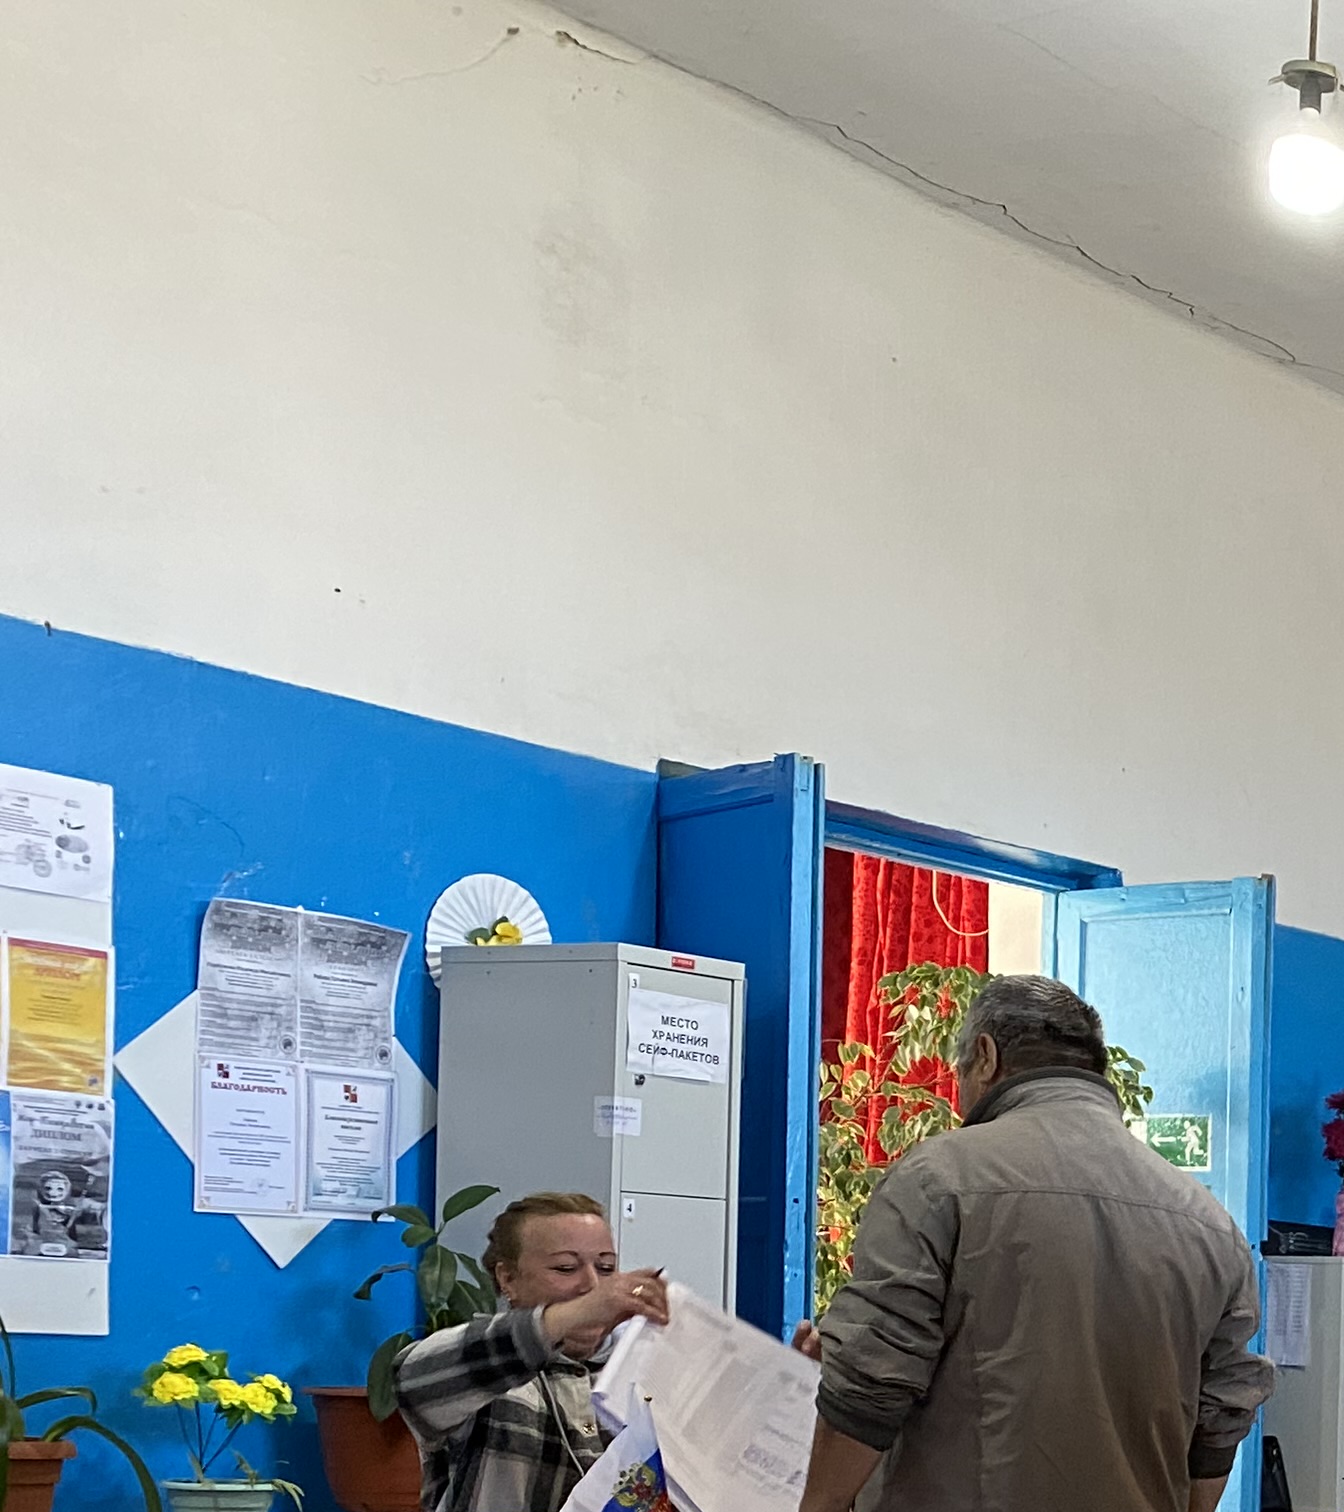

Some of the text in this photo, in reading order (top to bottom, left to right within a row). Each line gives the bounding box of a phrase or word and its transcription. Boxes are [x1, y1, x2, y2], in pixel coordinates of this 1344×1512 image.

[660, 1015, 699, 1031] МЕСТО
[651, 1029, 709, 1048] ХРАНЕНИЯ
[638, 1043, 720, 1066] СЕЙФ-ПАКЕТОВ
[210, 1081, 288, 1096] БЛАГОДАРНОСТЬ
